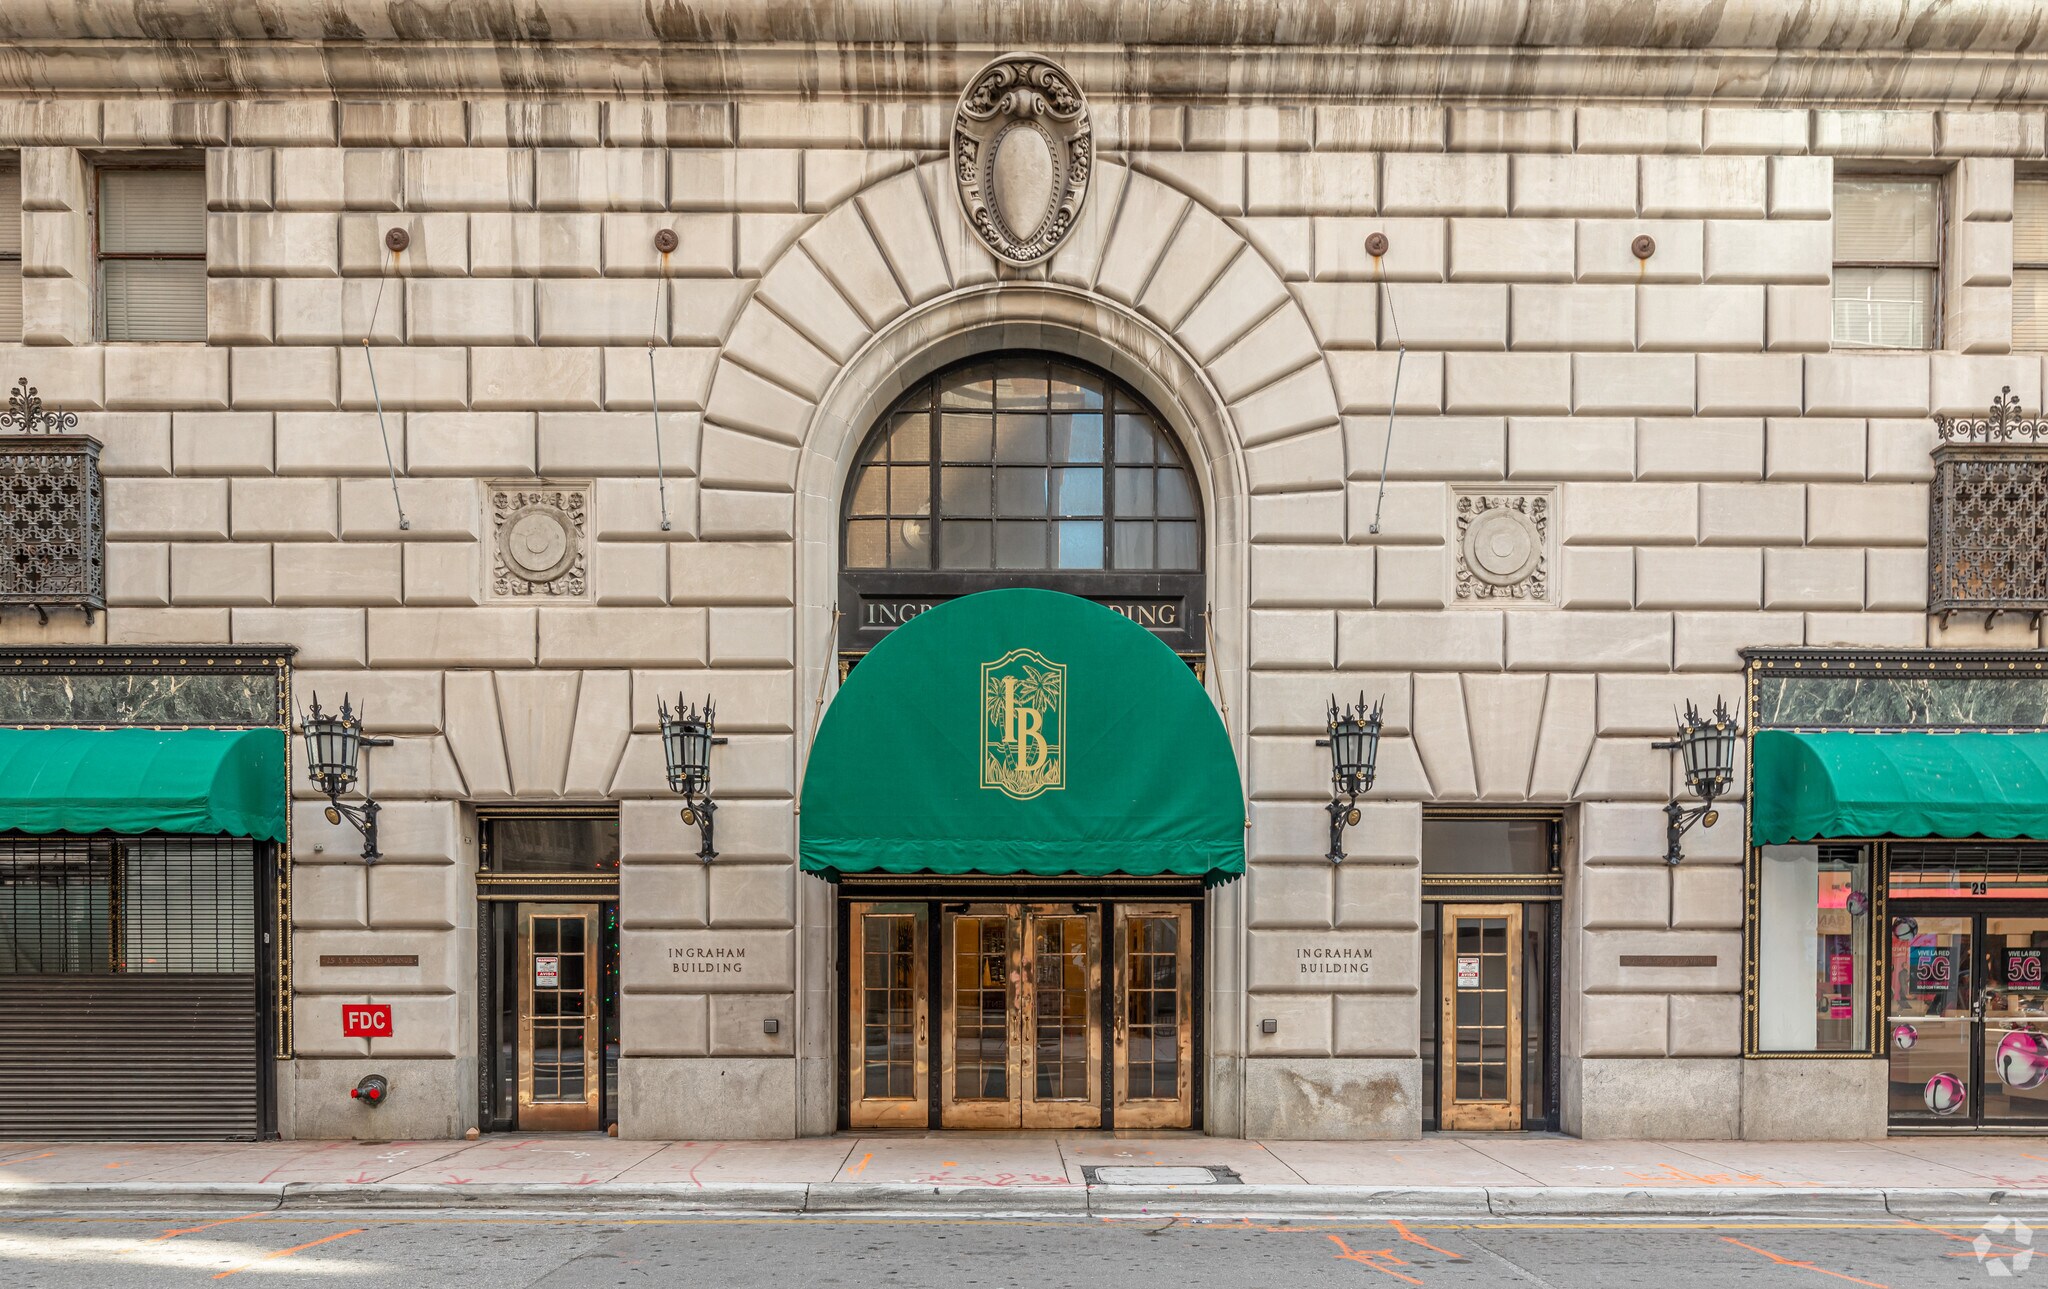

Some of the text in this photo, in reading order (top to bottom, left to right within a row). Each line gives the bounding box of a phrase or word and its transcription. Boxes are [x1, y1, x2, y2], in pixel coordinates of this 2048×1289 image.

[1972, 882, 1987, 895] 29
[668, 948, 745, 958] INGRAHAM
[1297, 948, 1373, 958] INGRAHAM
[673, 963, 742, 973] BUILDING
[1300, 963, 1369, 973] BUILDING
[1916, 956, 1950, 981] 5G
[2007, 957, 2041, 981] 5G
[349, 1011, 386, 1029] FDC
